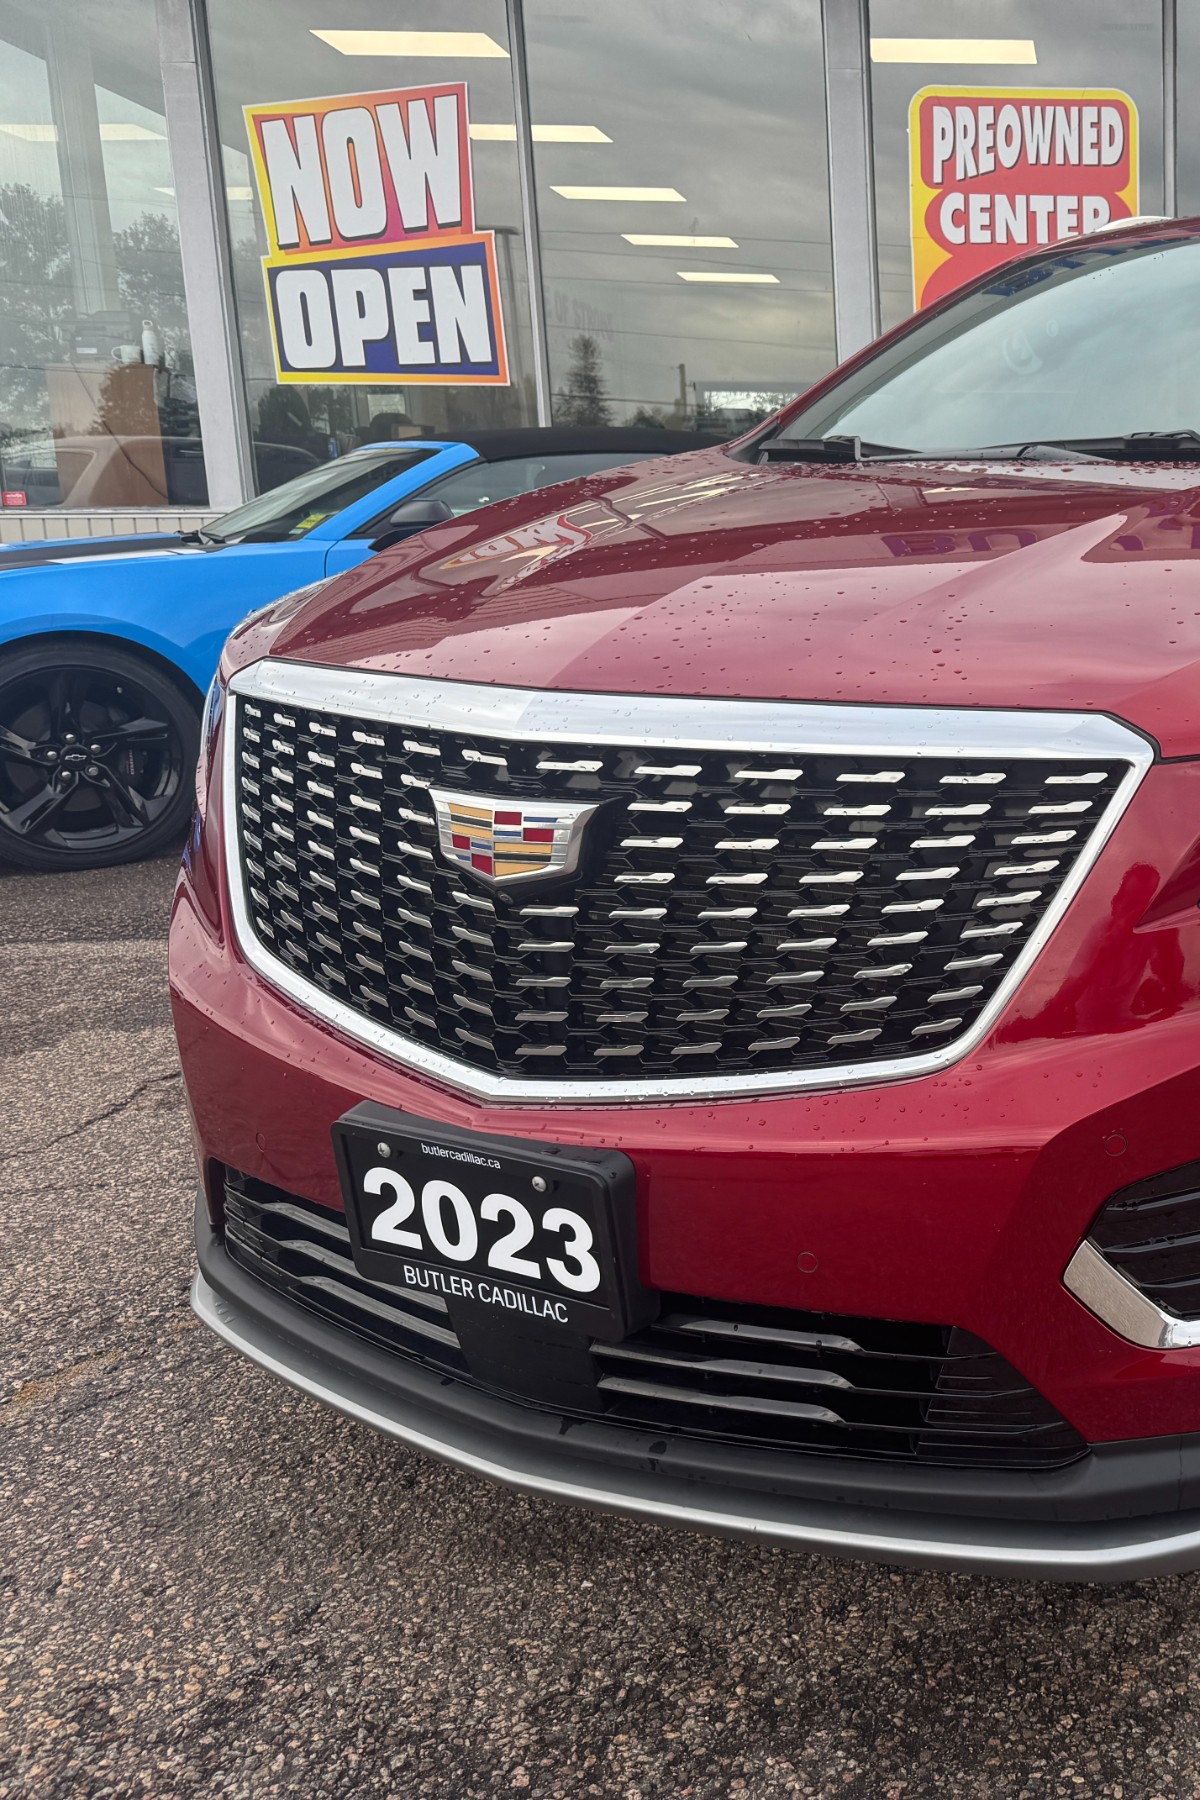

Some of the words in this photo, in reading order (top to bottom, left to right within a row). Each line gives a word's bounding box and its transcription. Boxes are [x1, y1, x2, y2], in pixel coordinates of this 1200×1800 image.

[260, 94, 462, 250] NOW
[933, 104, 1124, 185] PREOWNED
[275, 265, 493, 370] OPEN
[421, 1143, 501, 1169] butlercadillac.ca
[363, 1167, 601, 1293] 2023
[403, 1264, 475, 1299] BUTLER
[478, 1282, 569, 1324] CADILLAC
